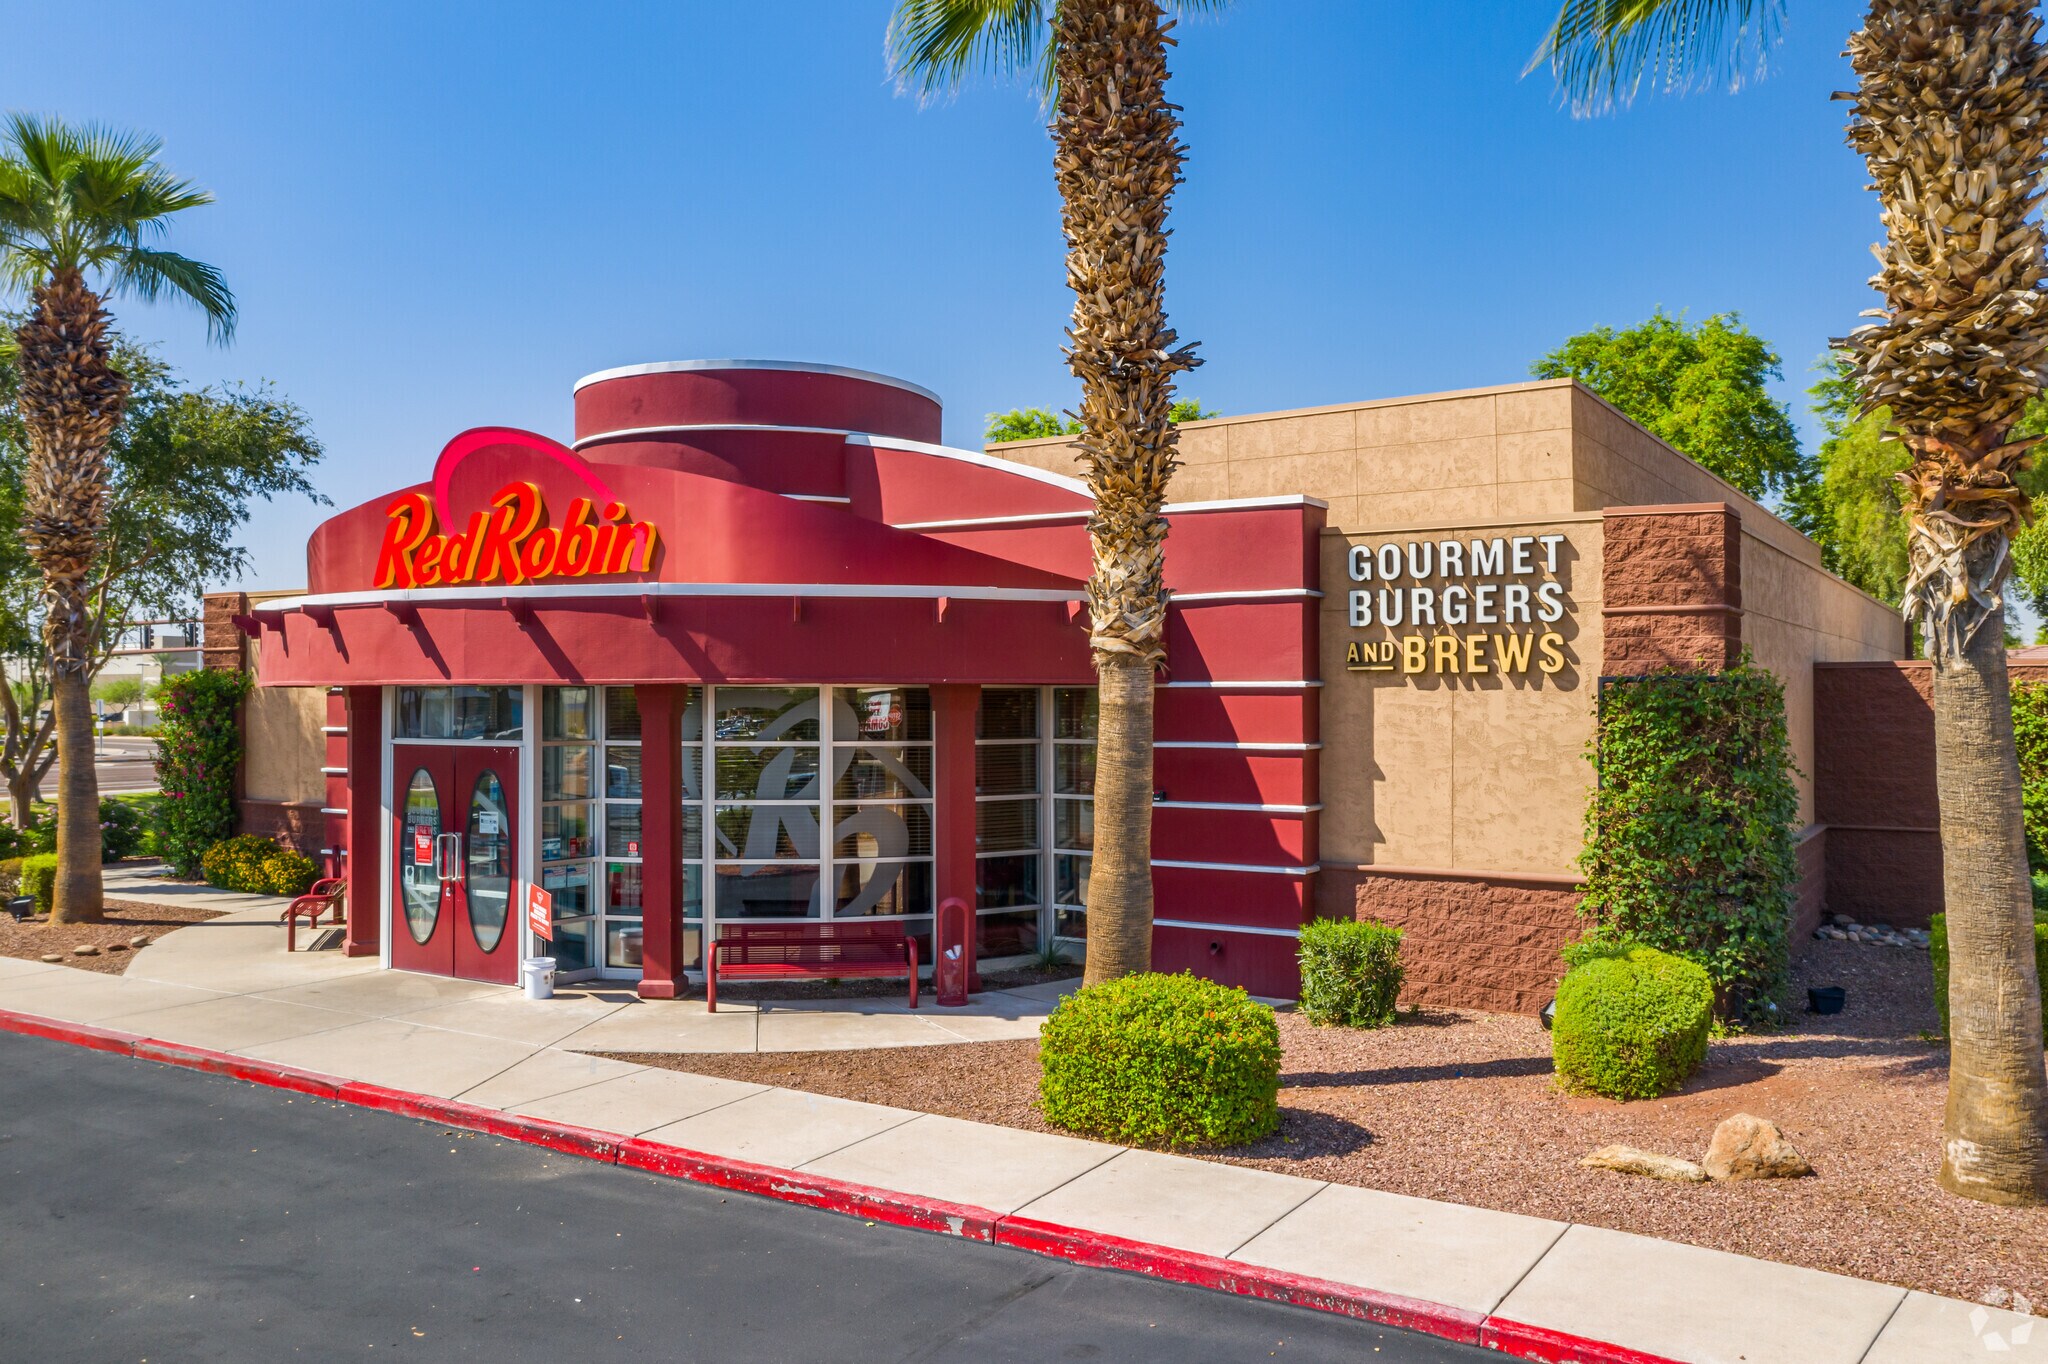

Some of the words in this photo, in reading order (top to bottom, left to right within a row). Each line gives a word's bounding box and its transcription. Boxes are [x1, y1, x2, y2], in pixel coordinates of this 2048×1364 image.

[1348, 534, 1565, 581] GOURMET
[1349, 581, 1564, 627] BURGERS
[1347, 641, 1395, 663] AND
[1403, 632, 1565, 674] BREWS
